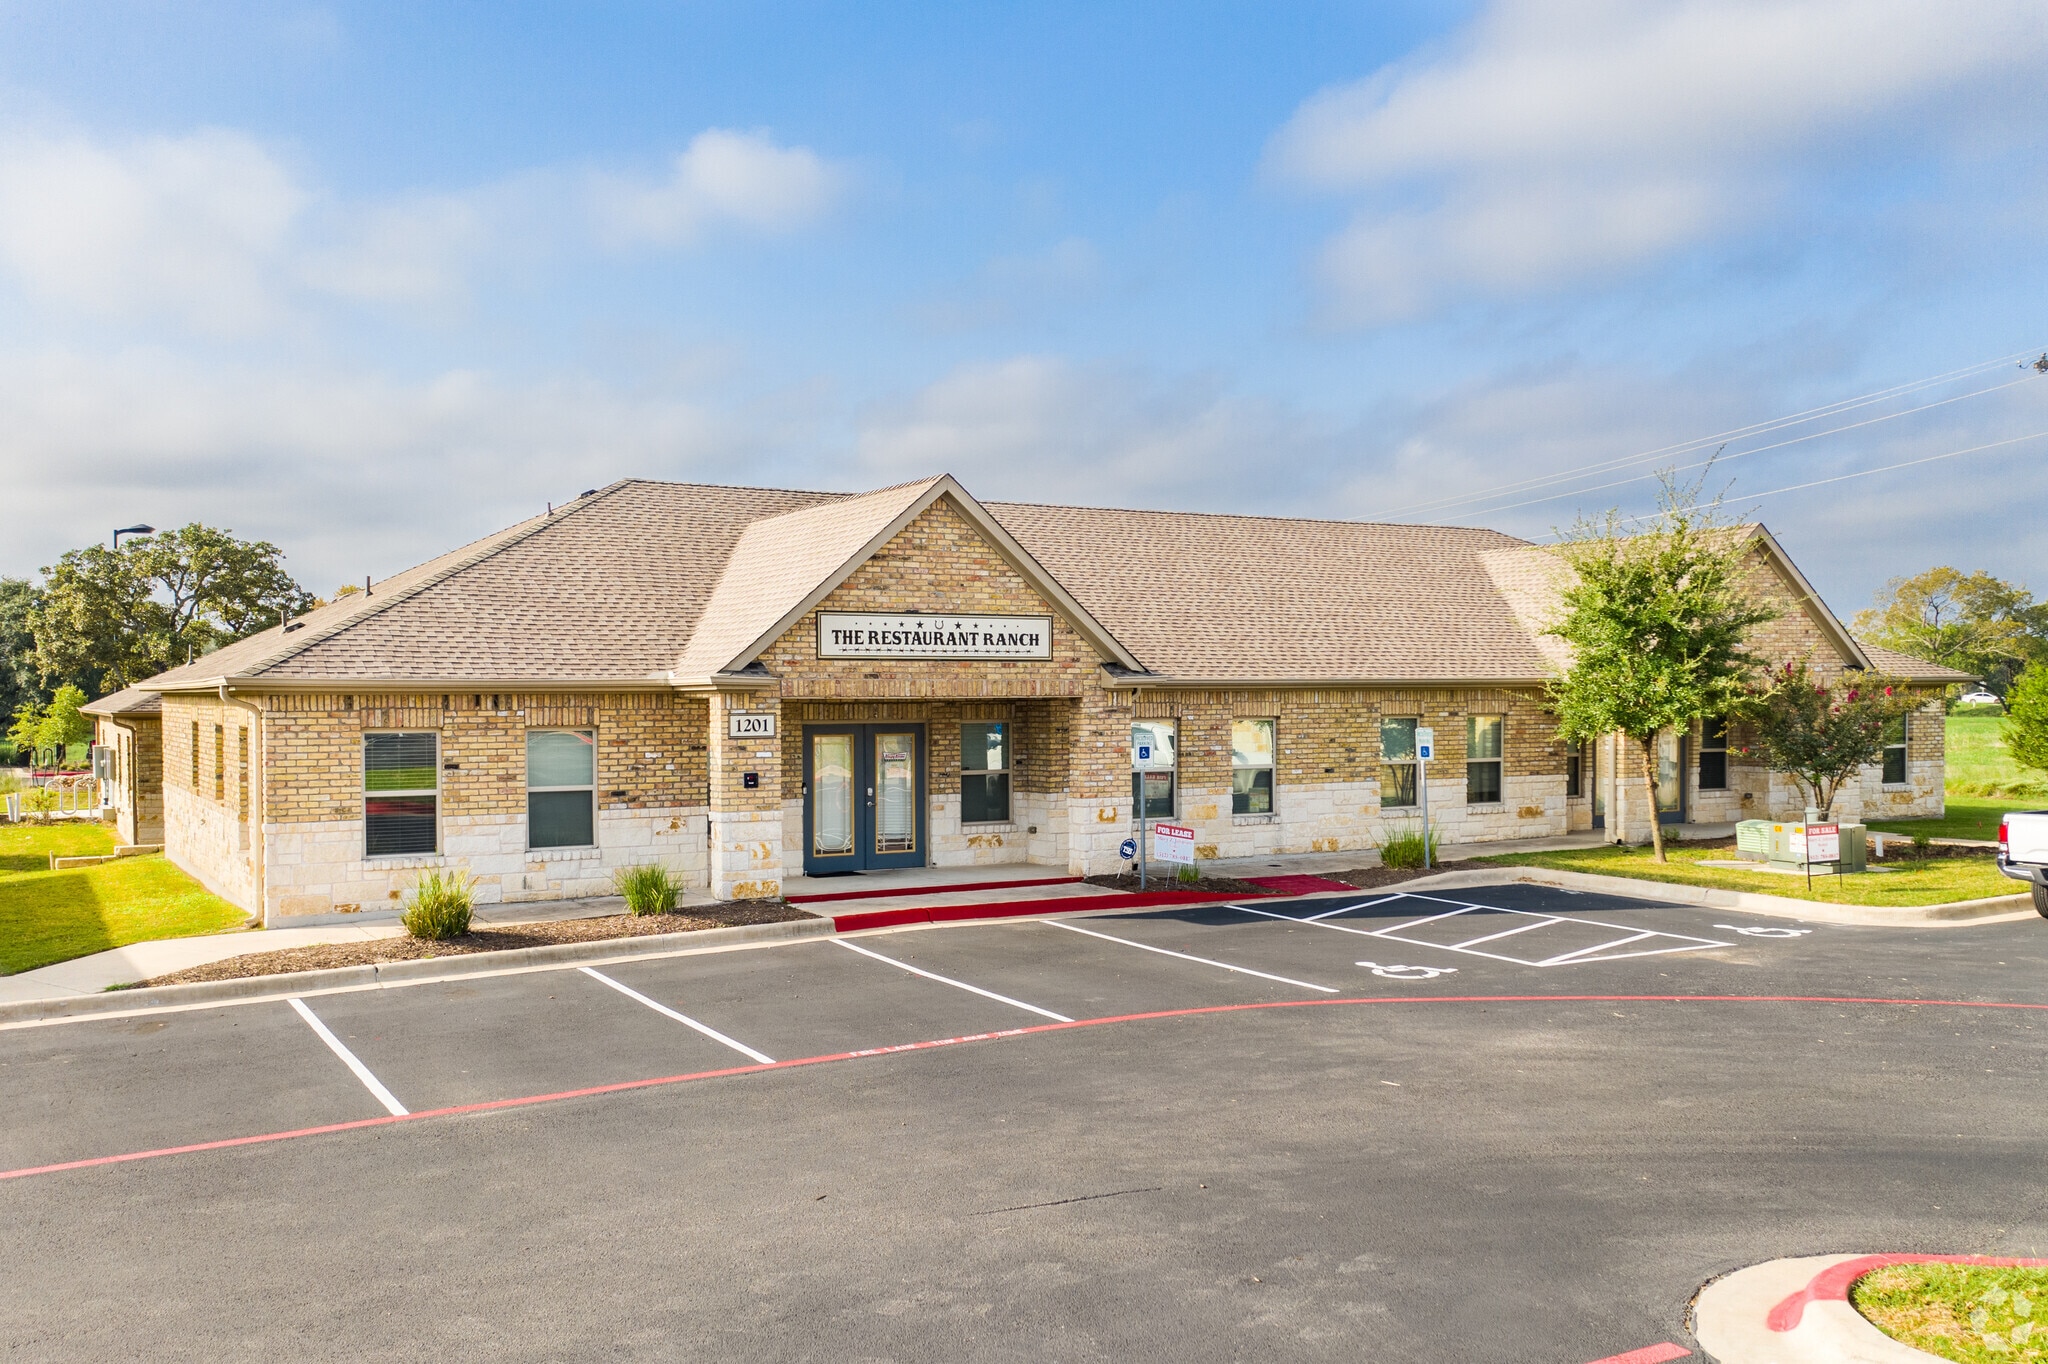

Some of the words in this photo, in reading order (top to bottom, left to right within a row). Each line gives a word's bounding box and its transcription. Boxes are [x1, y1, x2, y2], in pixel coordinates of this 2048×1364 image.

[831, 630, 864, 645] THE
[868, 631, 979, 646] RESTAURANT
[983, 633, 1040, 646] RANCH
[736, 719, 768, 732] 1201
[1157, 826, 1171, 835] FOR
[1171, 828, 1193, 839] LEASE
[1821, 826, 1837, 834] SALE
